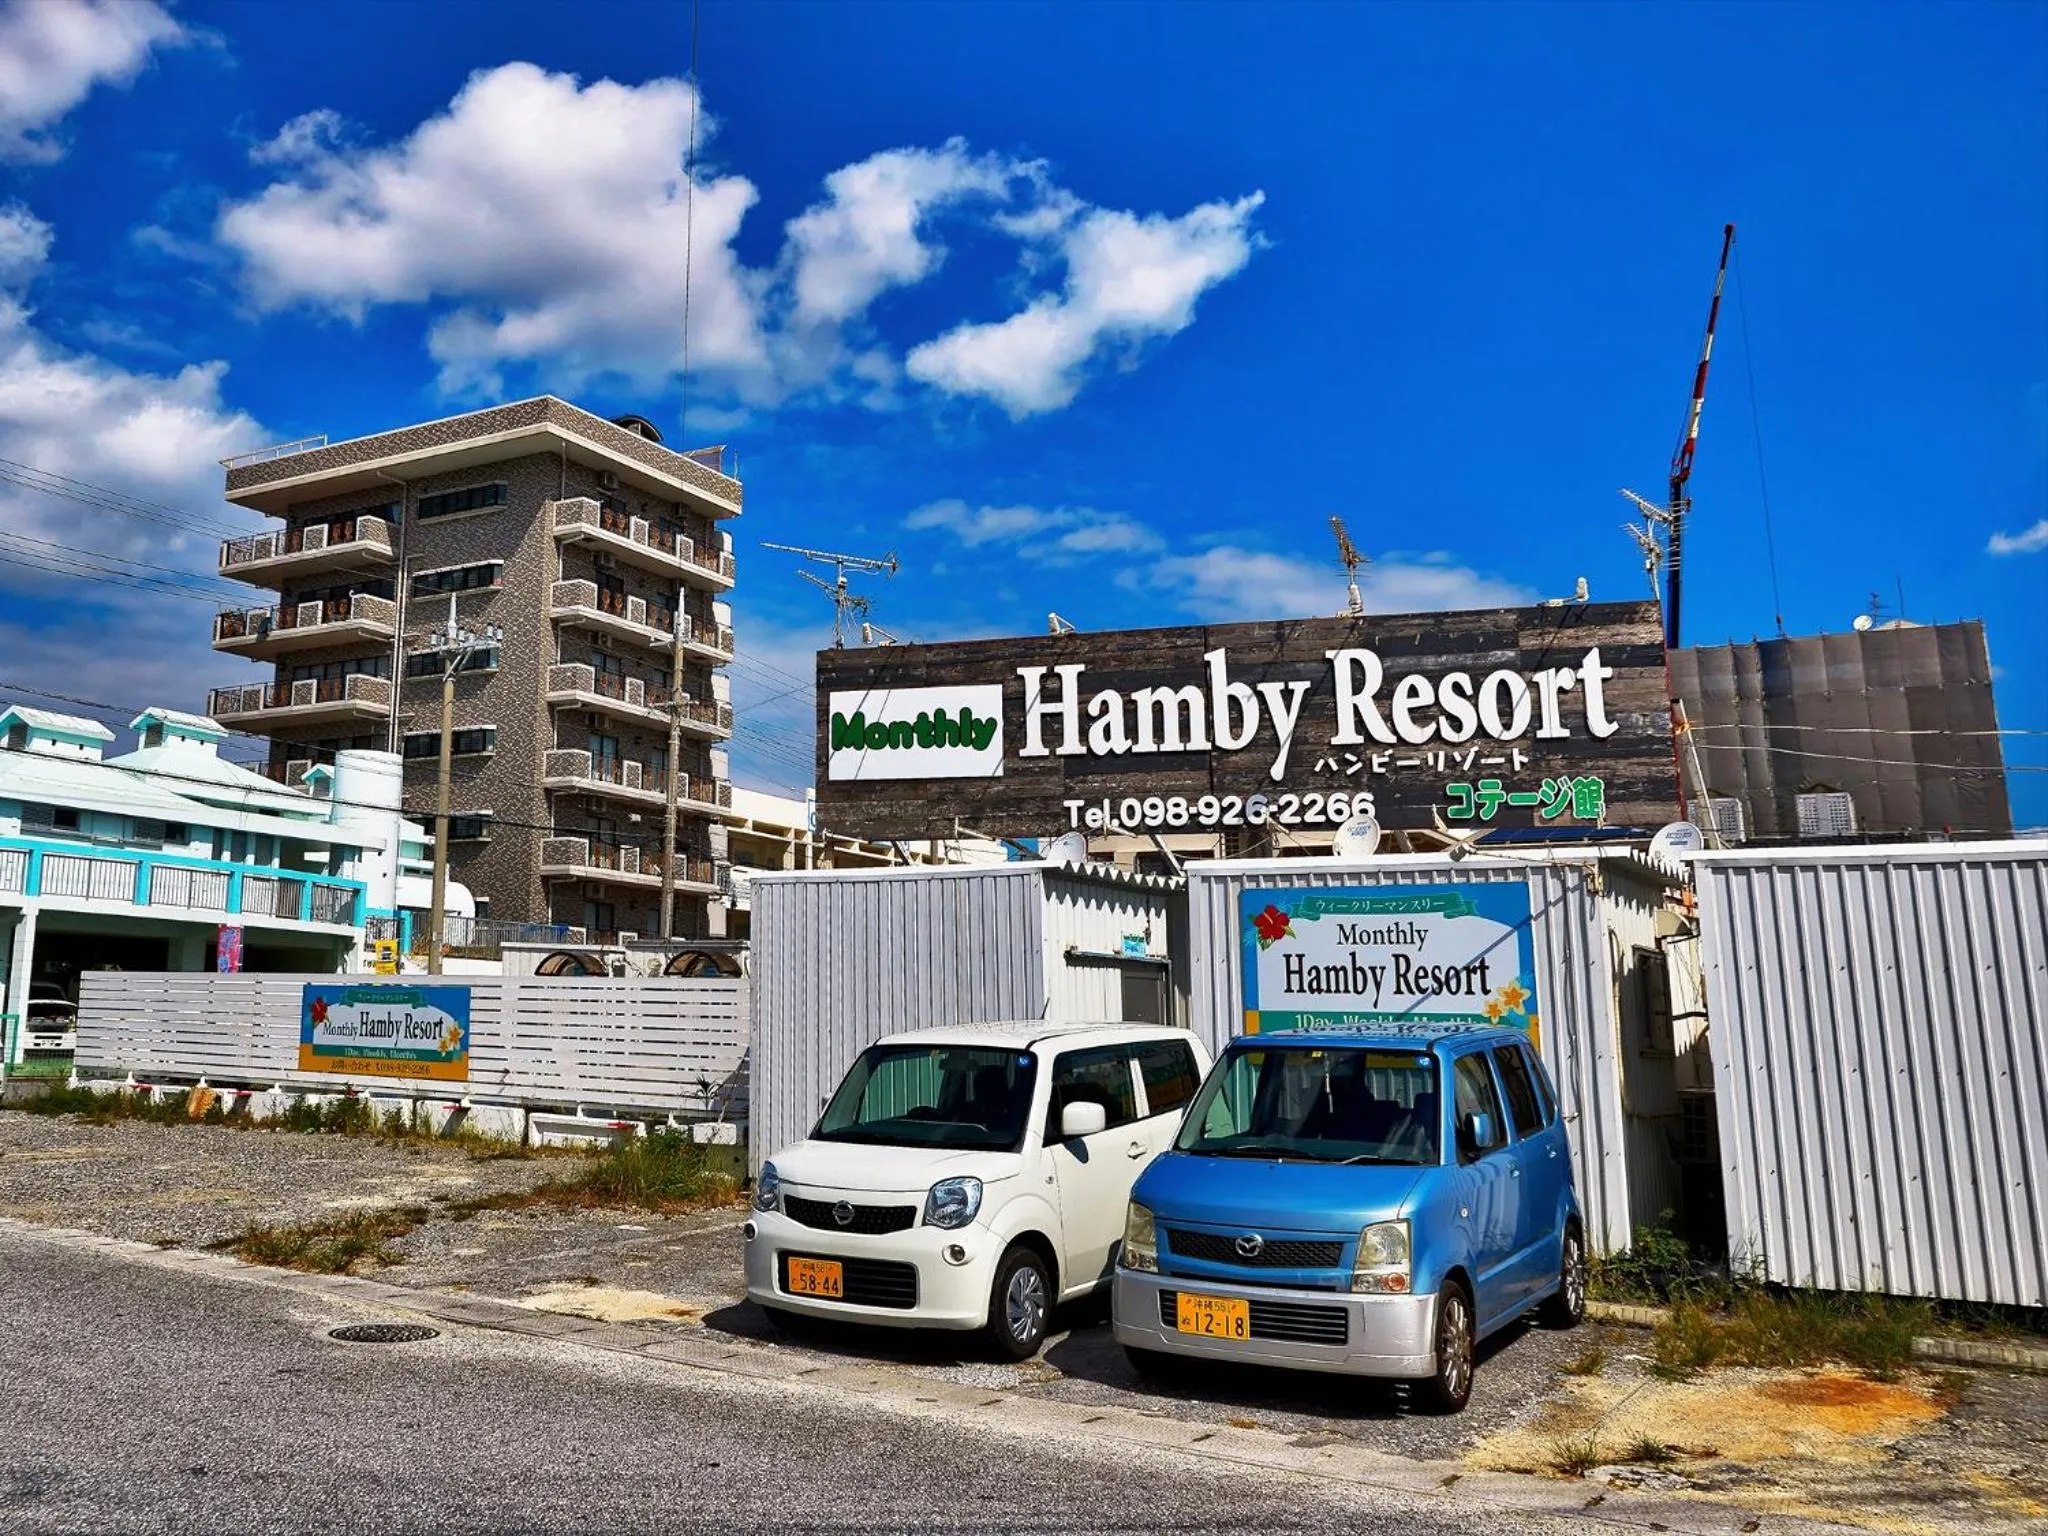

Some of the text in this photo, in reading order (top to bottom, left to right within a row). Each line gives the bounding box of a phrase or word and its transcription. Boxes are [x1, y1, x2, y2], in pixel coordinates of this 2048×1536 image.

[831, 706, 998, 752] Monthly
[1016, 646, 1620, 782] Hamby Resort
[1314, 746, 1530, 776] ハンビーリゾート
[1446, 776, 1607, 821] コテージ館
[1314, 899, 1446, 912] ウィークリーマンスリー
[1336, 922, 1429, 951] Monthly
[1283, 951, 1492, 1009] Hamby Resort
[323, 1011, 444, 1048] Monthly Hamby Resort
[800, 1273, 839, 1294] 58-44
[1195, 1312, 1245, 1337] 12-18
